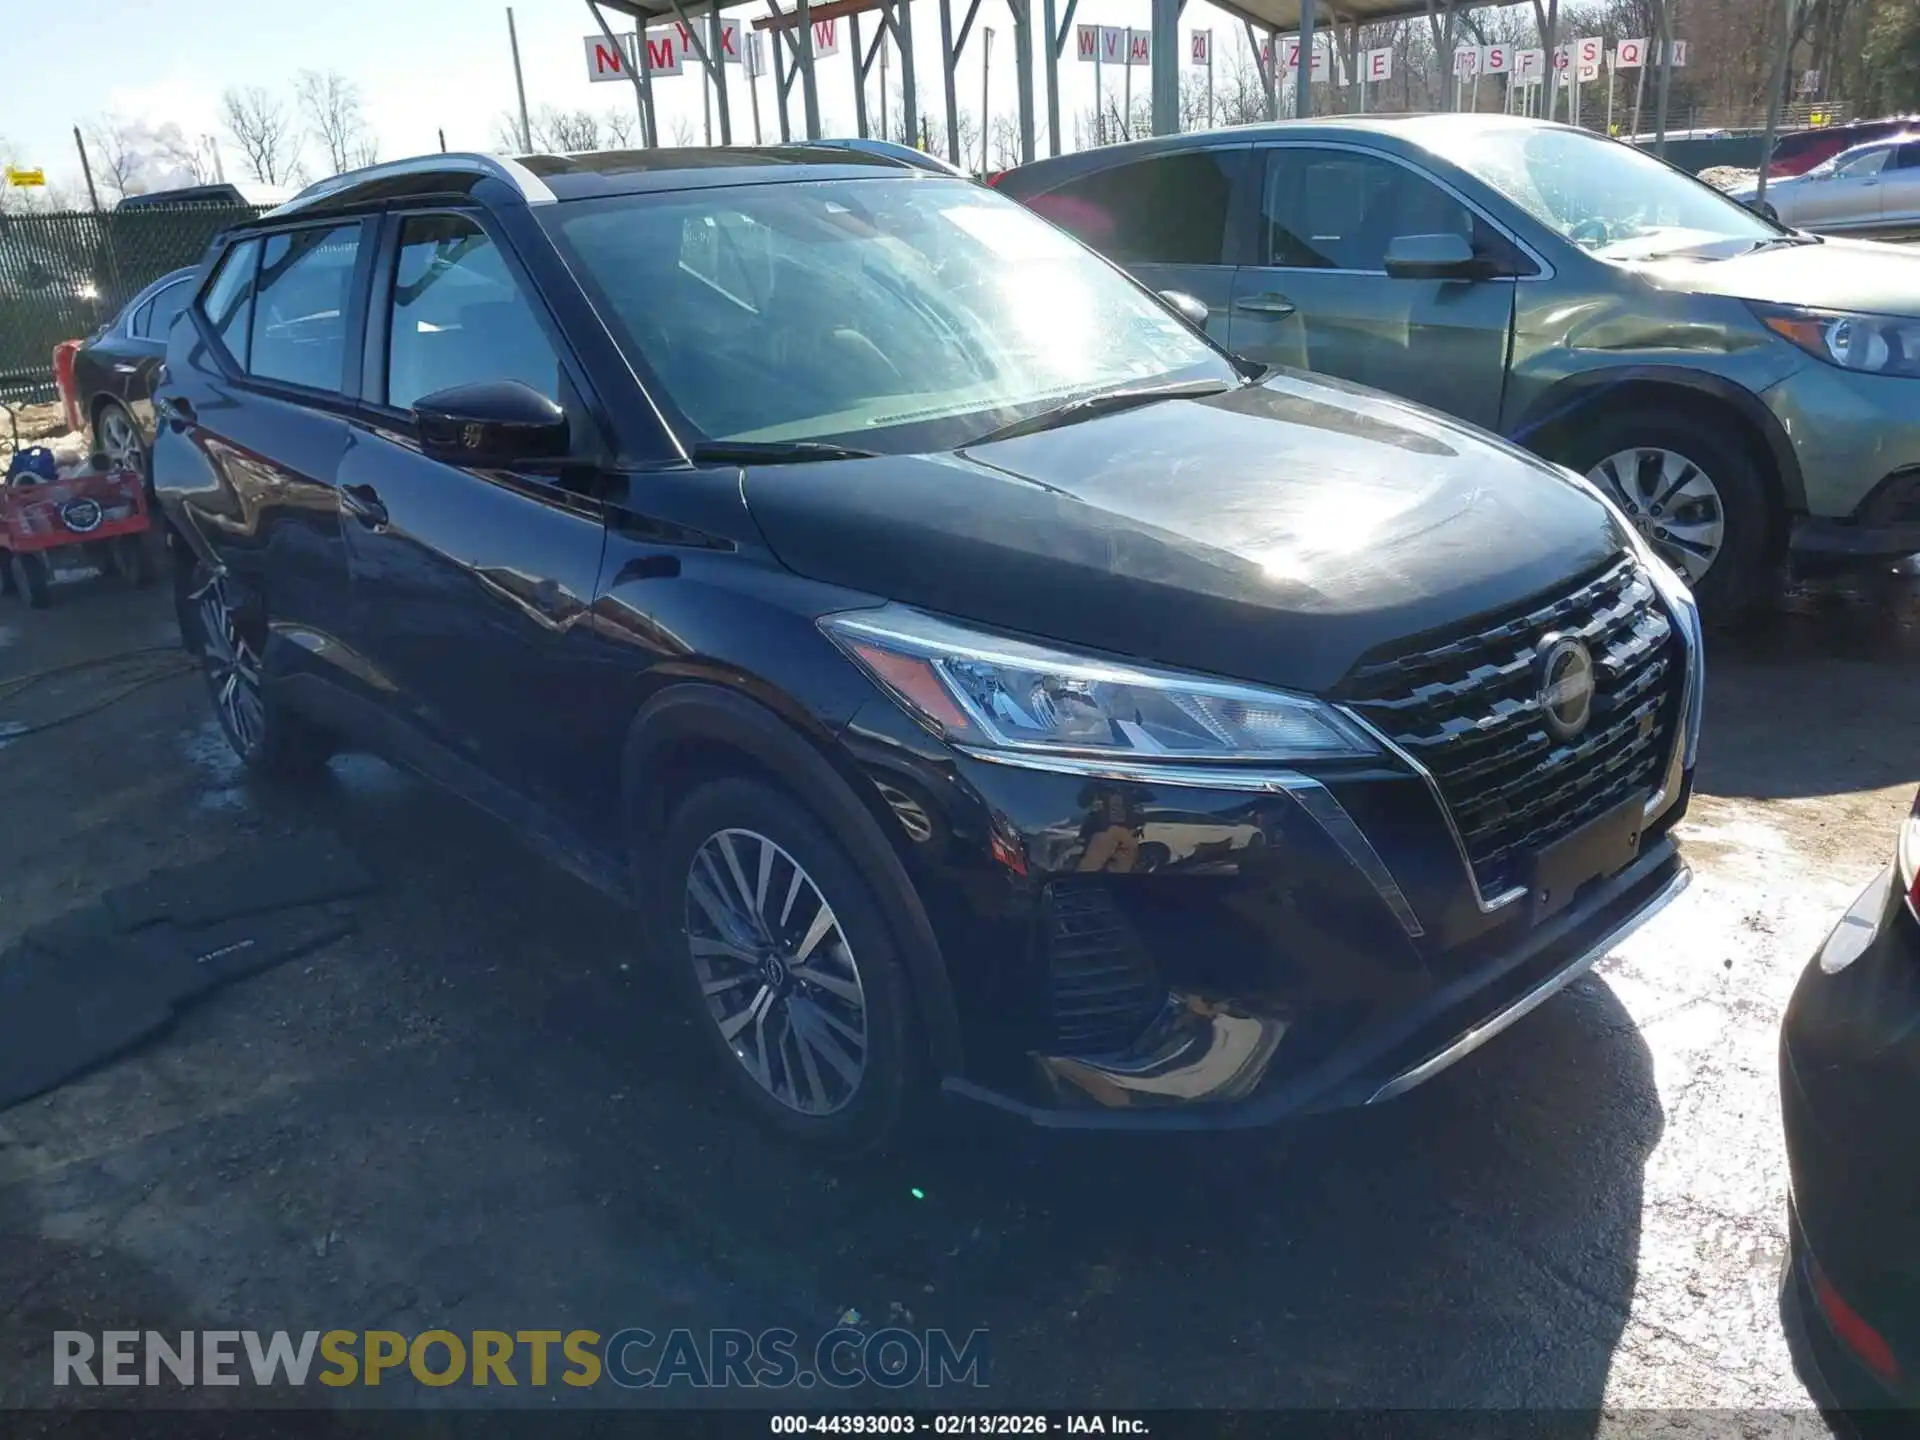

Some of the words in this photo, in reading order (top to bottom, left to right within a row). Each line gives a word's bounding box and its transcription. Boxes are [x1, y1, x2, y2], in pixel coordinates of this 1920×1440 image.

[815, 20, 835, 49] W
[1080, 31, 1095, 55] W
[1105, 32, 1117, 56] V
[595, 44, 621, 73] N
[647, 38, 675, 70] M
[1132, 36, 1149, 59] AA
[1193, 35, 1206, 59] 20
[1489, 49, 1503, 68] S
[1582, 43, 1596, 61] S
[1622, 44, 1638, 64] Q
[1373, 54, 1385, 75] E
[1522, 54, 1534, 72] F
